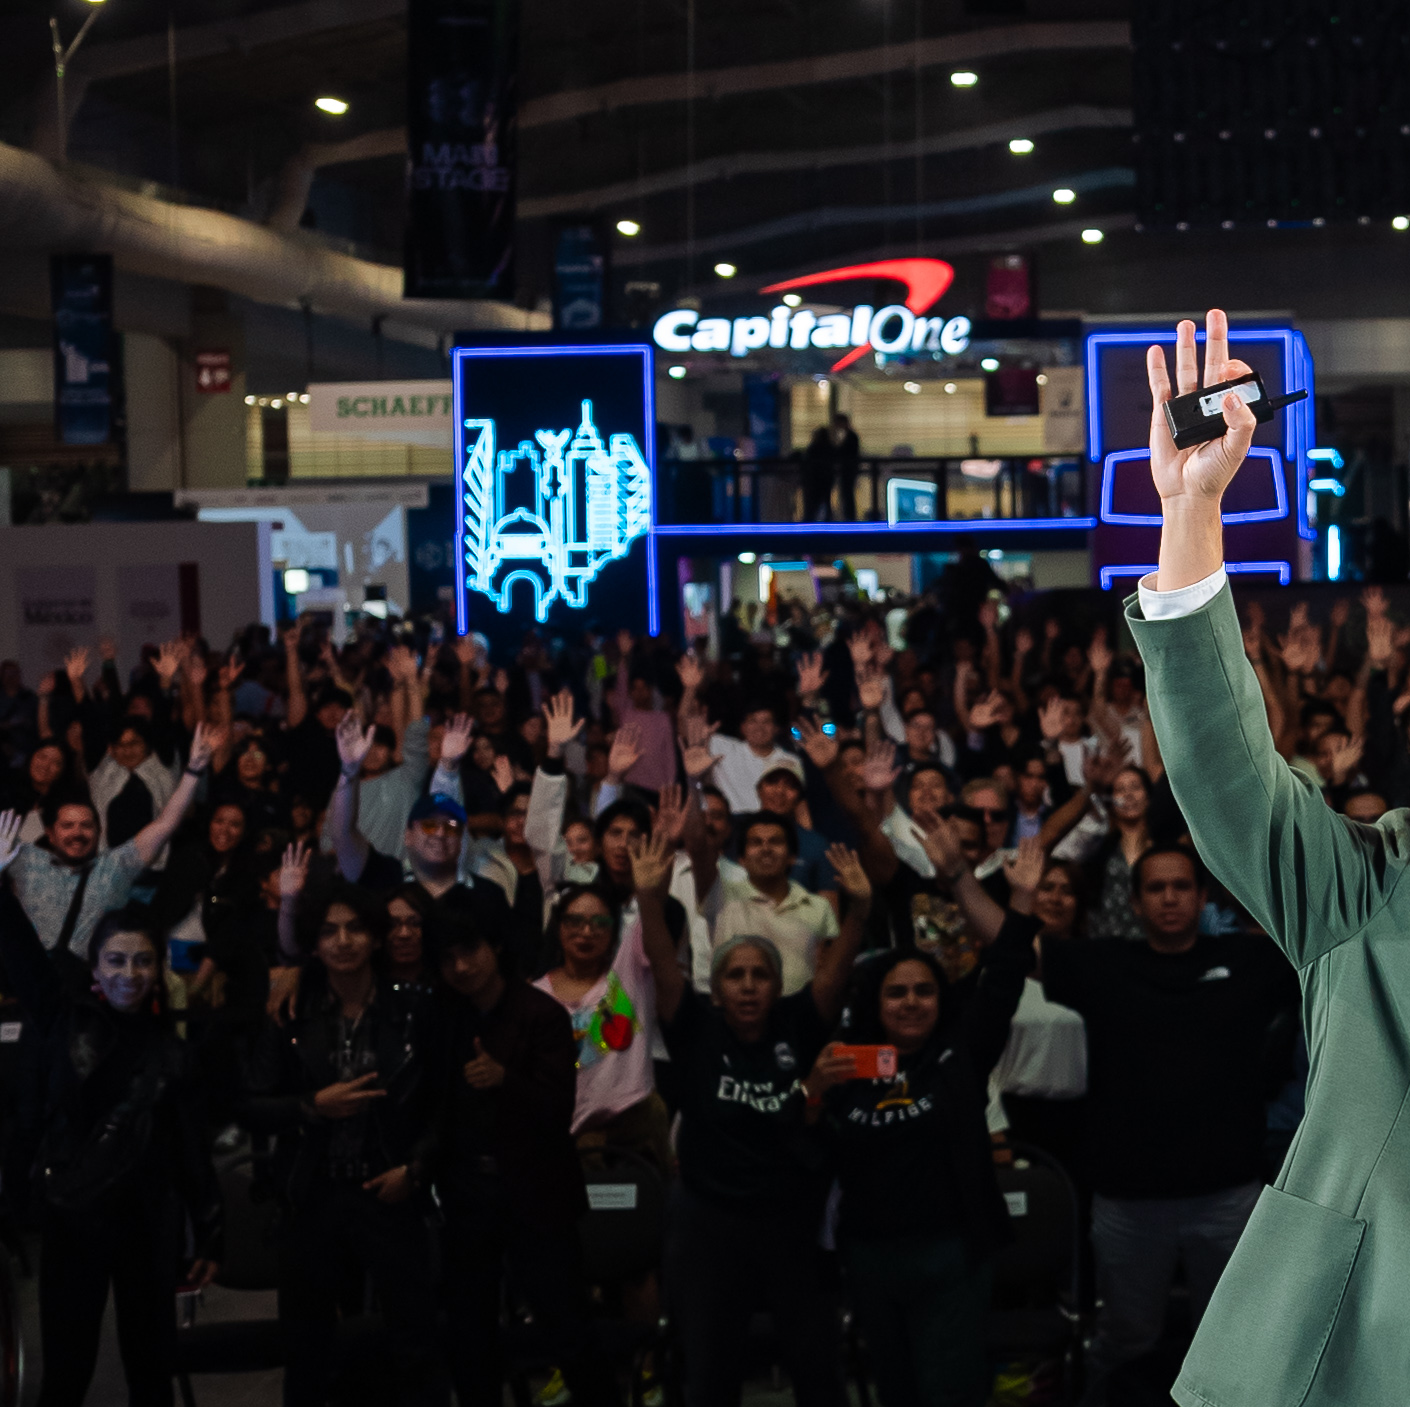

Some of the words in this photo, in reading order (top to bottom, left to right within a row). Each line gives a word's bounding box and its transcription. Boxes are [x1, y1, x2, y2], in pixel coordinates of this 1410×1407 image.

[422, 142, 499, 169] MAIN
[414, 166, 510, 192] STAGE
[848, 1094, 934, 1127] HILFIGE
